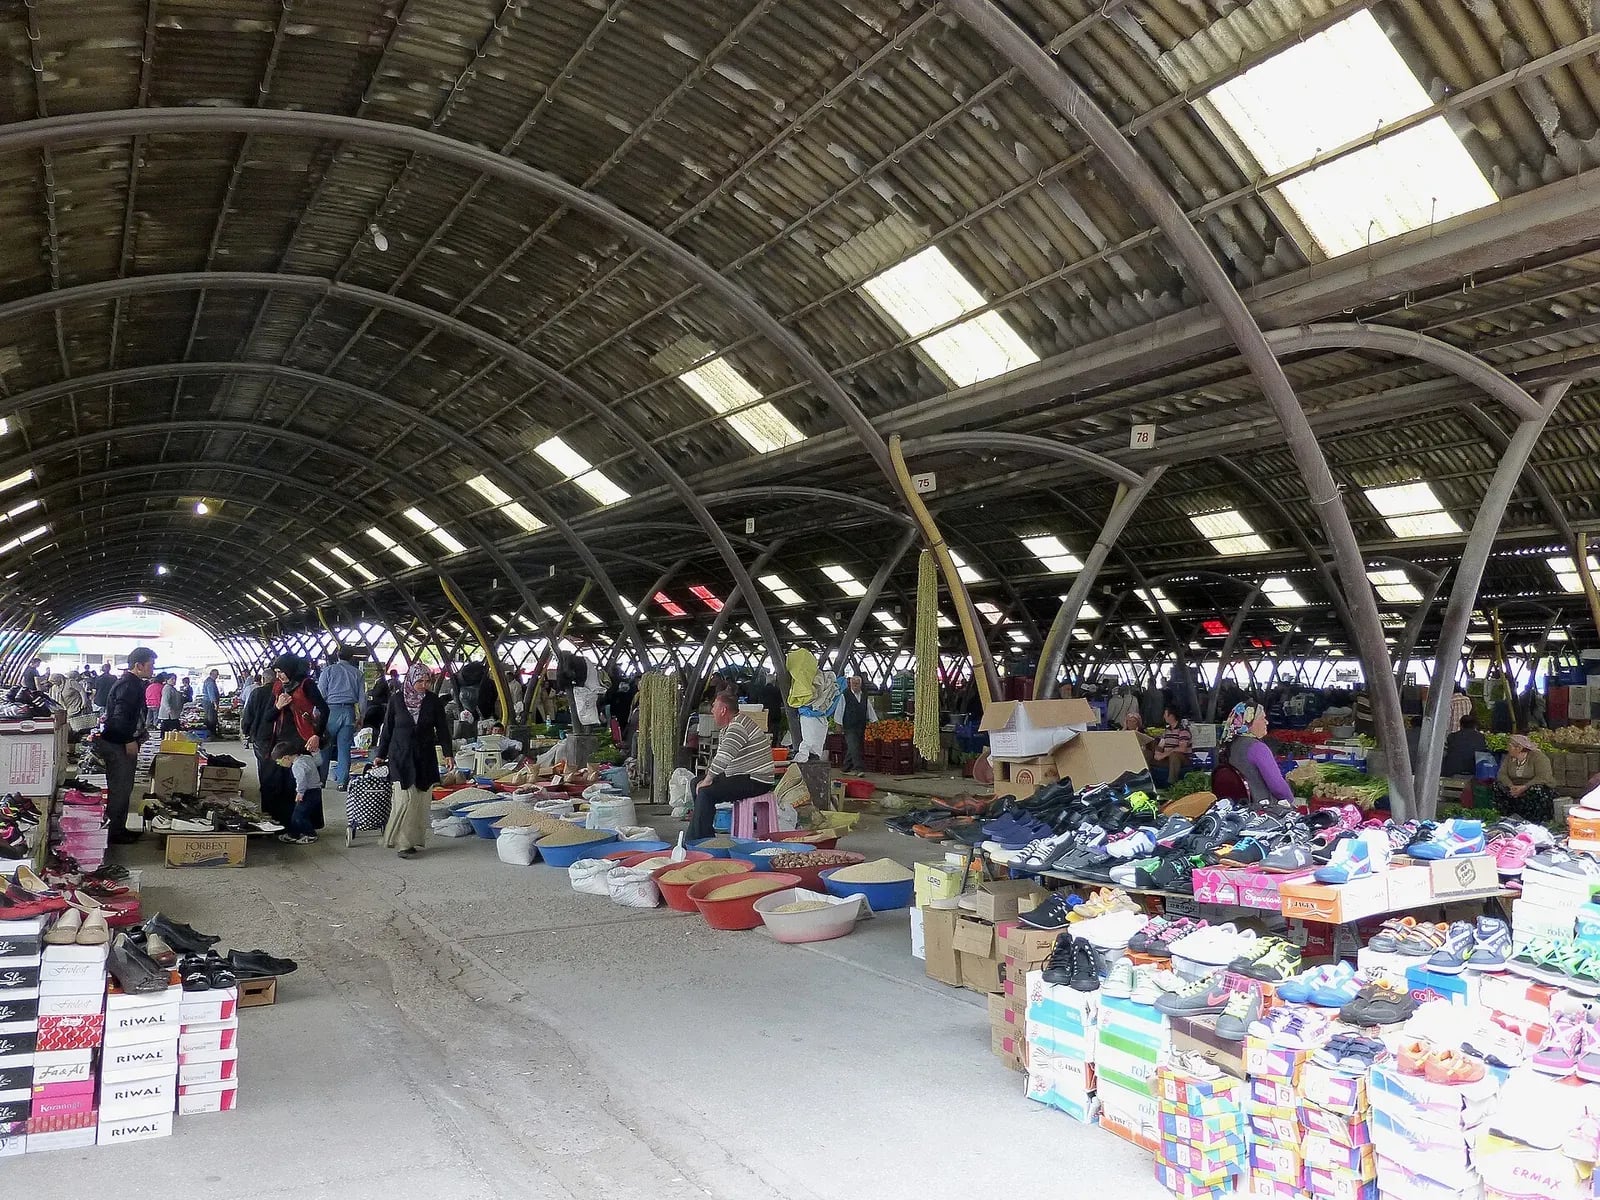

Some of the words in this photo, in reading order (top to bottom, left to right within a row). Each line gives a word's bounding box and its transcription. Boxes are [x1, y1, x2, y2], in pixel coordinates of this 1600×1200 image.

[1136, 432, 1149, 443] 78
[917, 478, 930, 488] 75
[184, 841, 230, 851] FORBEST
[120, 1014, 166, 1027] RIWAL
[116, 1051, 163, 1063] RIWAL
[115, 1087, 161, 1099] RIWAL
[112, 1124, 158, 1136] RIWAL
[1513, 1166, 1562, 1189] ERMAX
